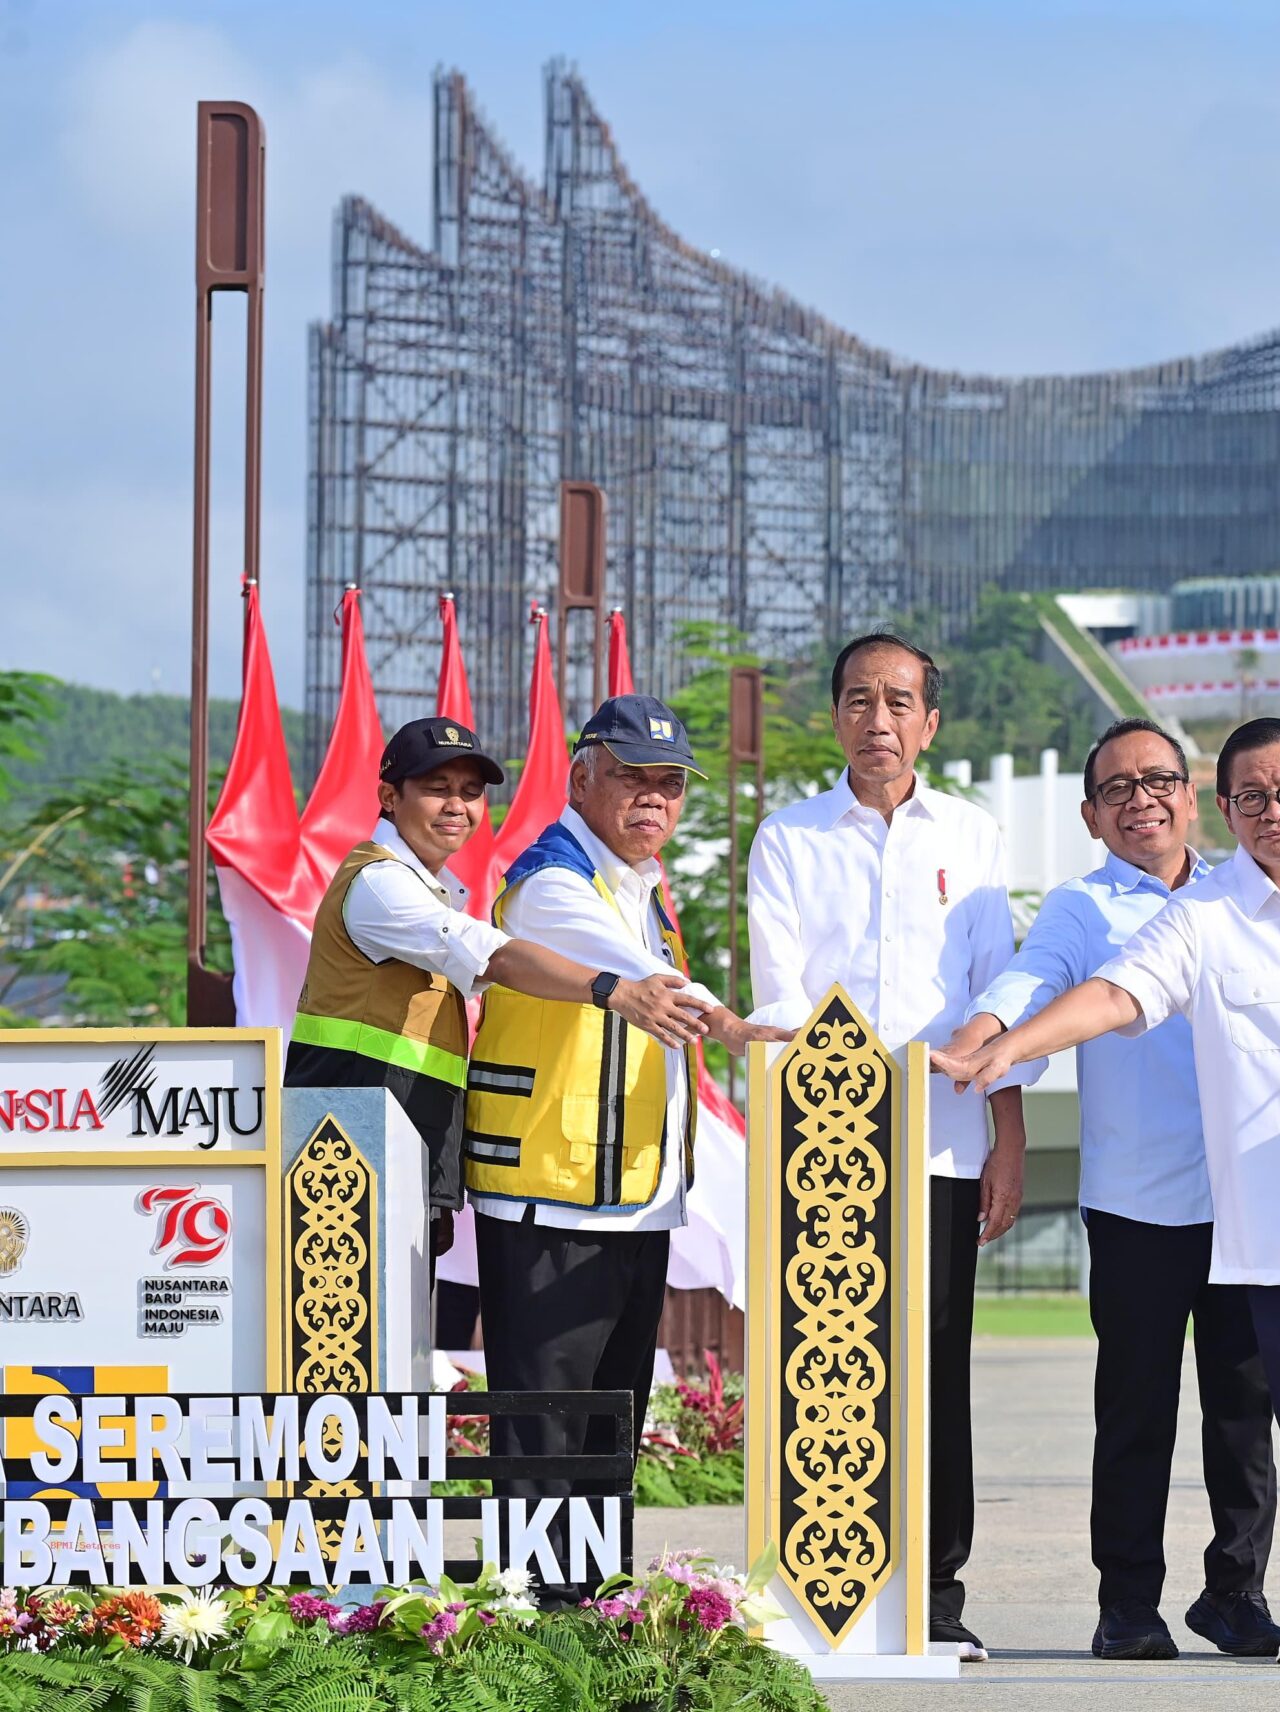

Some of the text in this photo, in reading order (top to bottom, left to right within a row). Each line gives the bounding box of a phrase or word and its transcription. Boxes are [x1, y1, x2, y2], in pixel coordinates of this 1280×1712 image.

[131, 1086, 266, 1150] MAJU
[142, 1187, 229, 1266] 79
[144, 1280, 229, 1291] NUSANTARA
[0, 1296, 81, 1318] NTARA
[144, 1293, 182, 1304] BARU
[144, 1309, 220, 1320] INDONESIA
[144, 1322, 184, 1333] MAJU
[29, 1394, 447, 1484] SEREMONI
[3, 1496, 622, 1587] BANGSAAN IKN
